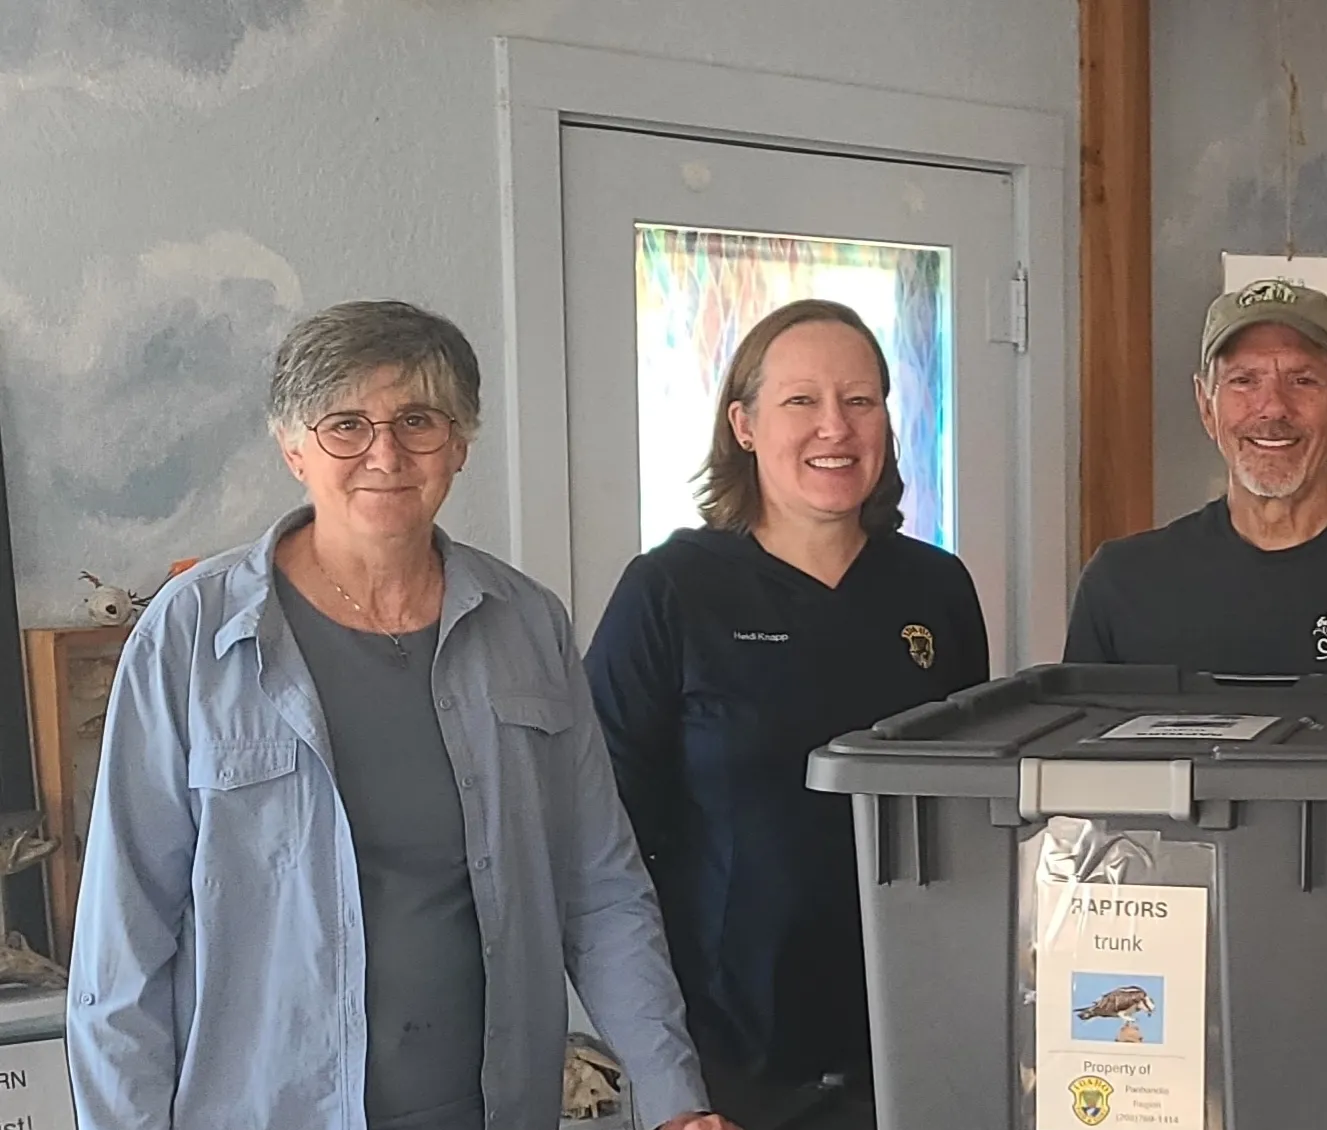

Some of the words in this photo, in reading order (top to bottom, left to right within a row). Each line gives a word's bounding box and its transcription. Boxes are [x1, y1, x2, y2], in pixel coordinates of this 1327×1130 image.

[733, 630, 757, 641] Heidi
[757, 632, 789, 642] Knapp
[1072, 897, 1168, 918] RAPTORS
[1094, 934, 1143, 952] trunk
[1083, 1061, 1136, 1077] Property
[1139, 1064, 1151, 1076] of
